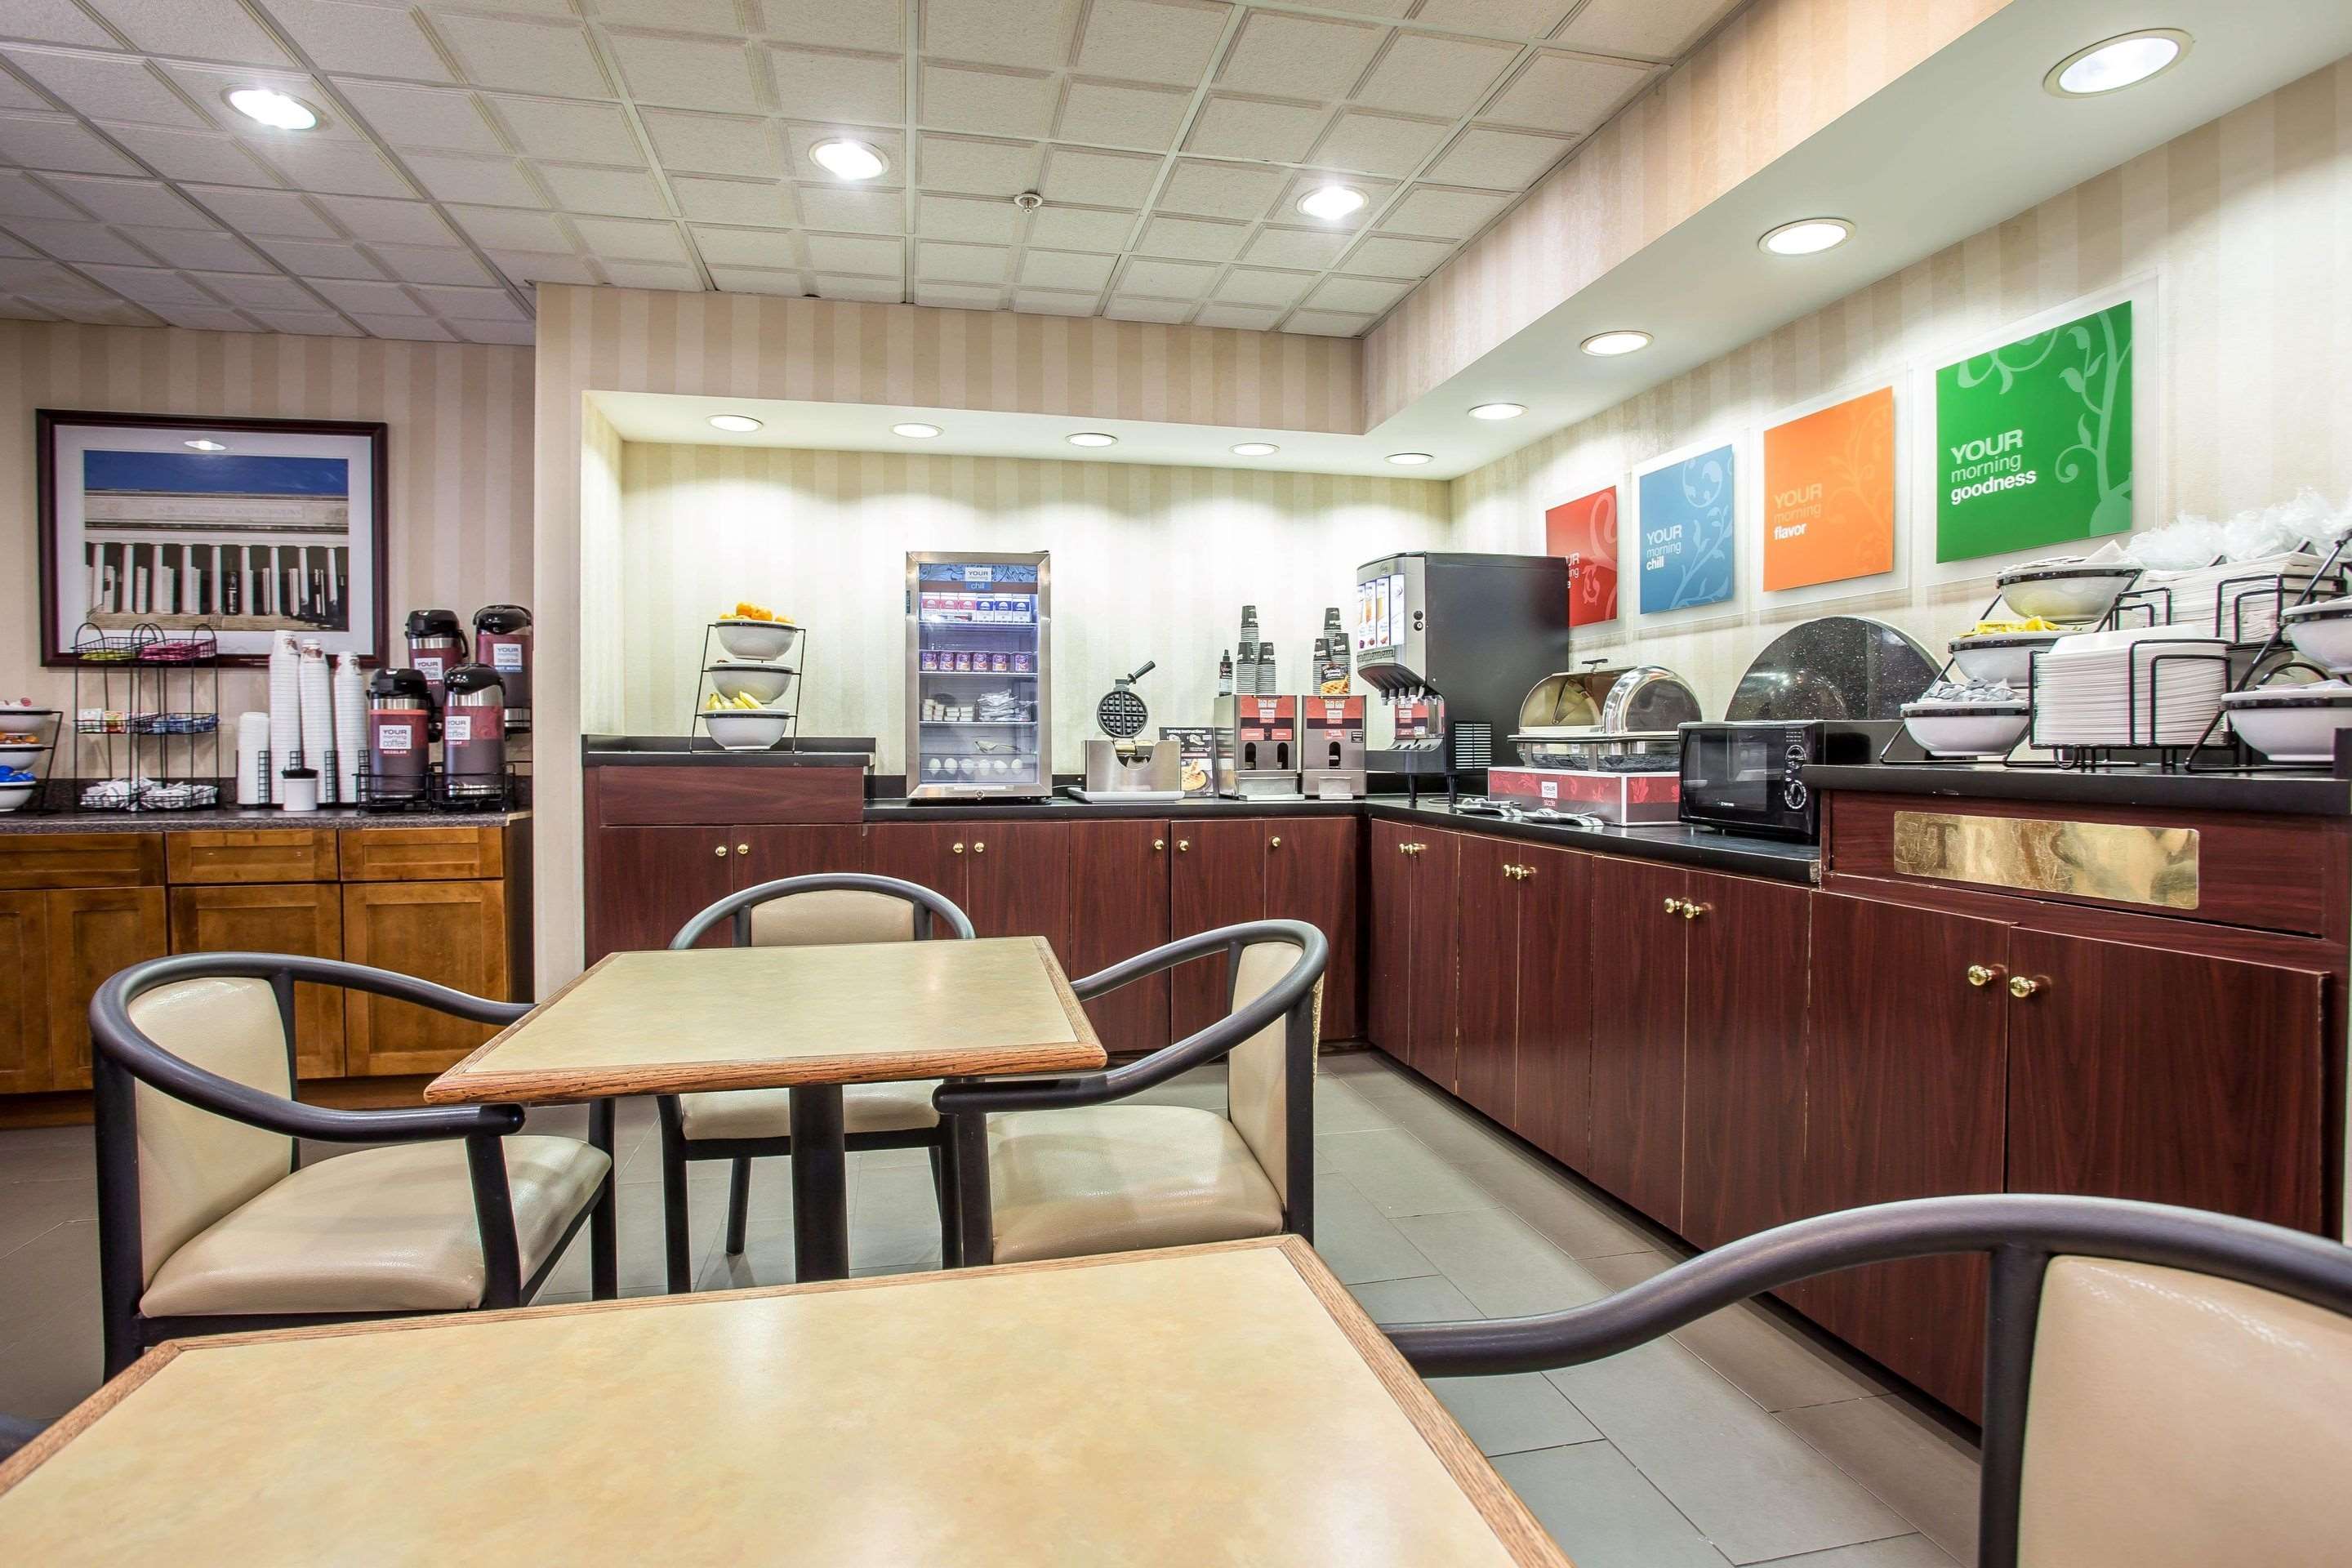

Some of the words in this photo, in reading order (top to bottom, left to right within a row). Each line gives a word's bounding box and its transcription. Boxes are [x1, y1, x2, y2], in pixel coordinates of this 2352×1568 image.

[1950, 429, 2024, 465] YOUR
[1951, 454, 2021, 483] morning
[1773, 483, 1822, 510] YOUR
[1950, 470, 2038, 506] goodness
[1774, 503, 1821, 523] morning
[1646, 524, 1682, 546] YOUR
[1774, 523, 1807, 541] flavor
[1646, 541, 1682, 559] morning
[1646, 555, 1664, 571] chill
[383, 739, 407, 747] coffee
